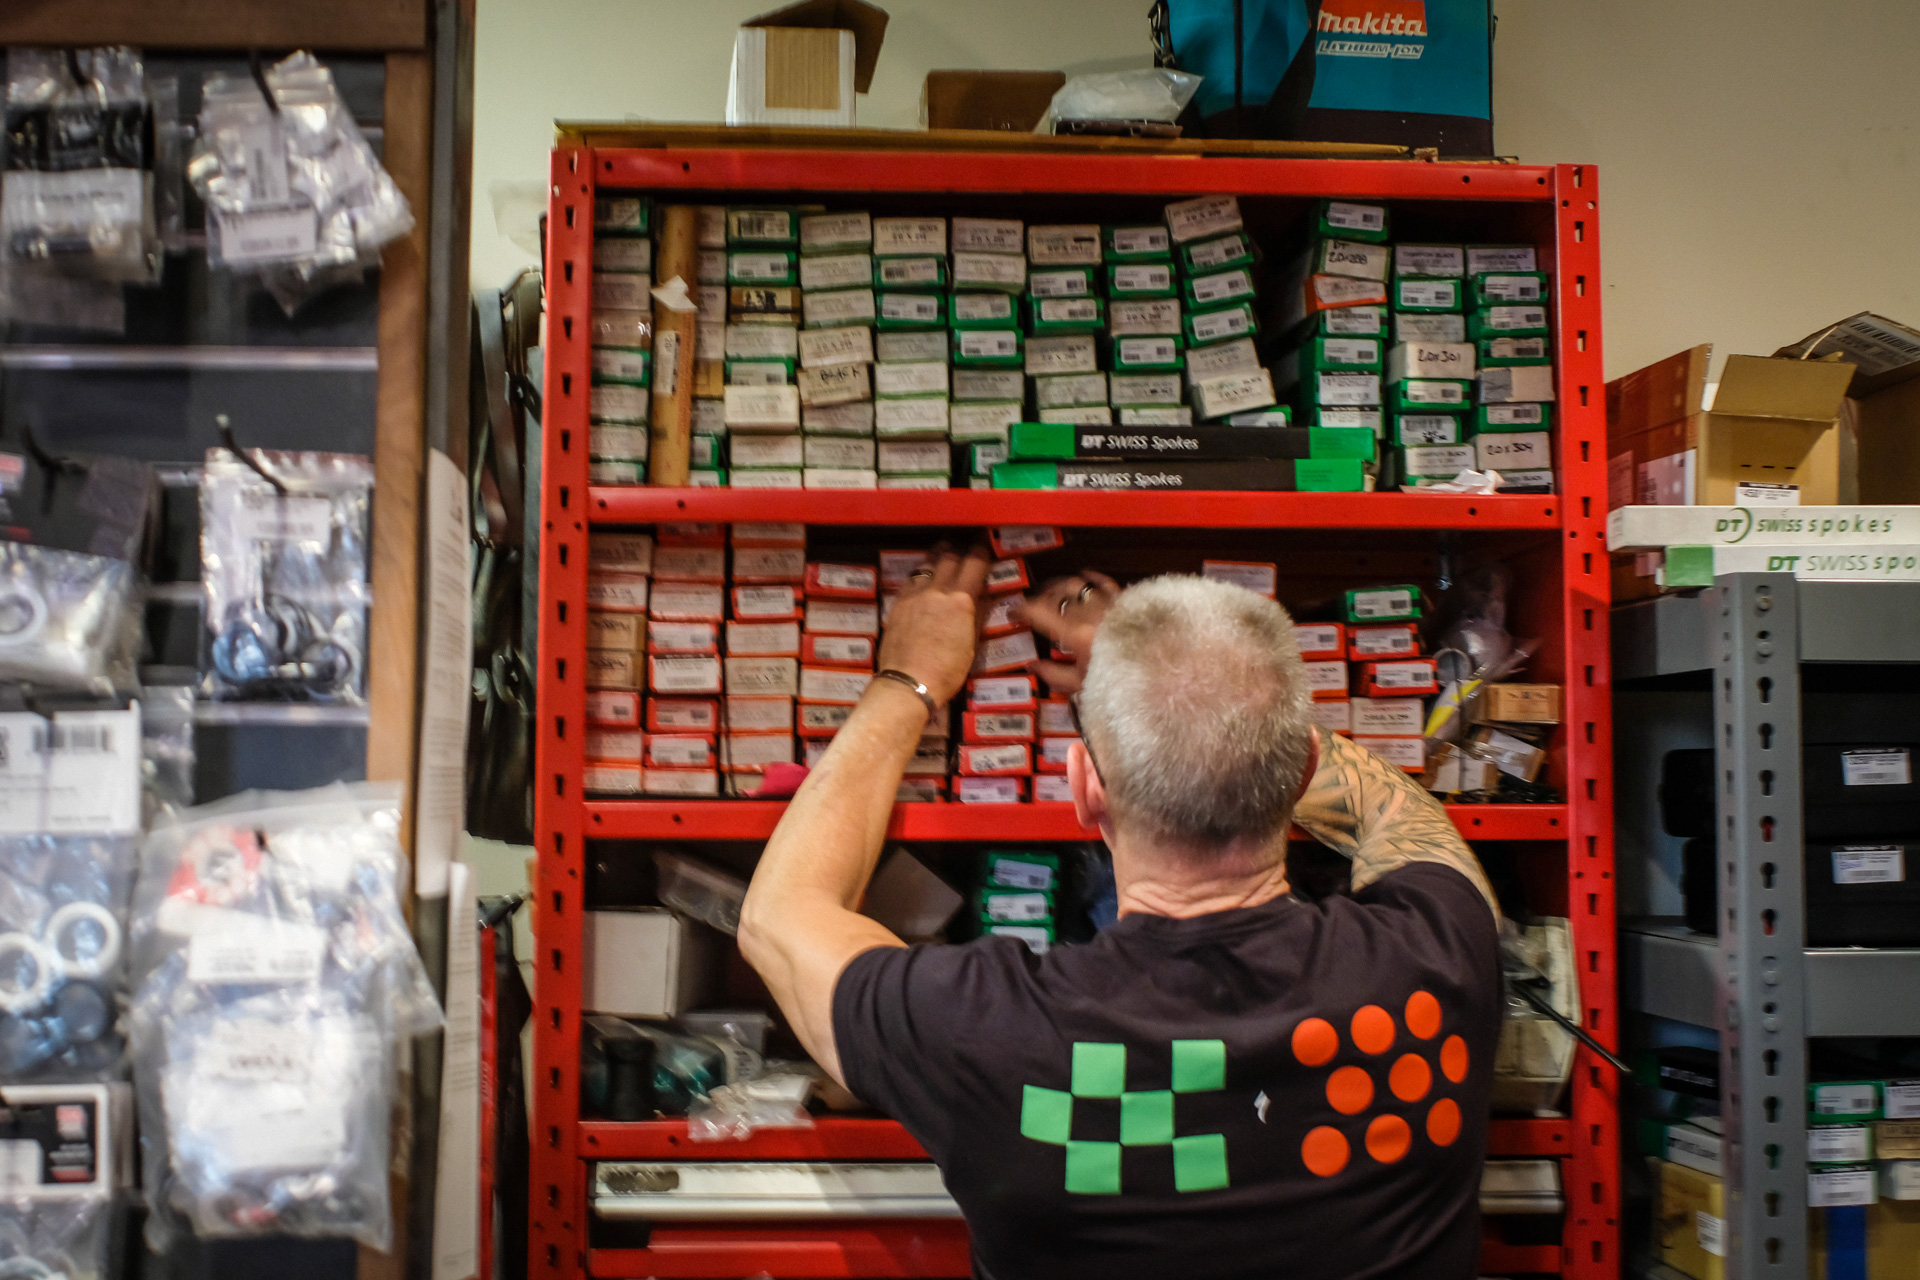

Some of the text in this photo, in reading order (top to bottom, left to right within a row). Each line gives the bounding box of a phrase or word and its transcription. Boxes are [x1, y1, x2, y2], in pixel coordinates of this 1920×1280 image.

[1316, 40, 1424, 59] LITHIUM-ION
[1081, 434, 1199, 452] DT SWISS Spokes
[1063, 472, 1183, 488] DT SWISS Spokes
[1715, 518, 1743, 533] DT
[1808, 514, 1892, 537] spokes
[1768, 556, 1801, 572] DT
[1806, 555, 1868, 571] SWISS
